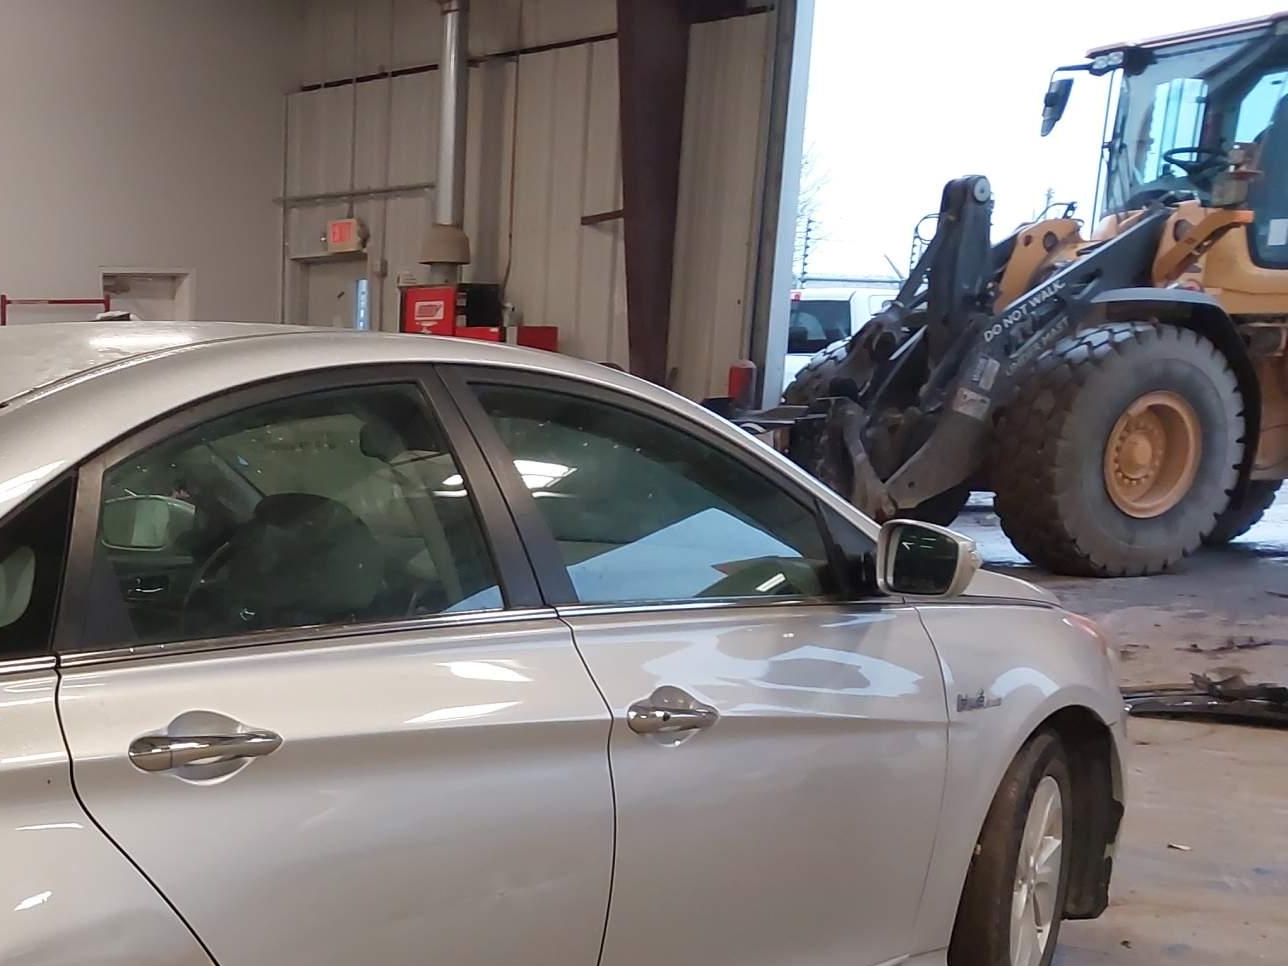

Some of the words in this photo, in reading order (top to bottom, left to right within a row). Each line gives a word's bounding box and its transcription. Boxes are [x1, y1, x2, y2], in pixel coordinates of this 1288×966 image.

[984, 324, 1002, 342] DO
[1003, 304, 1027, 328] NOT
[1028, 280, 1066, 306] WALK
